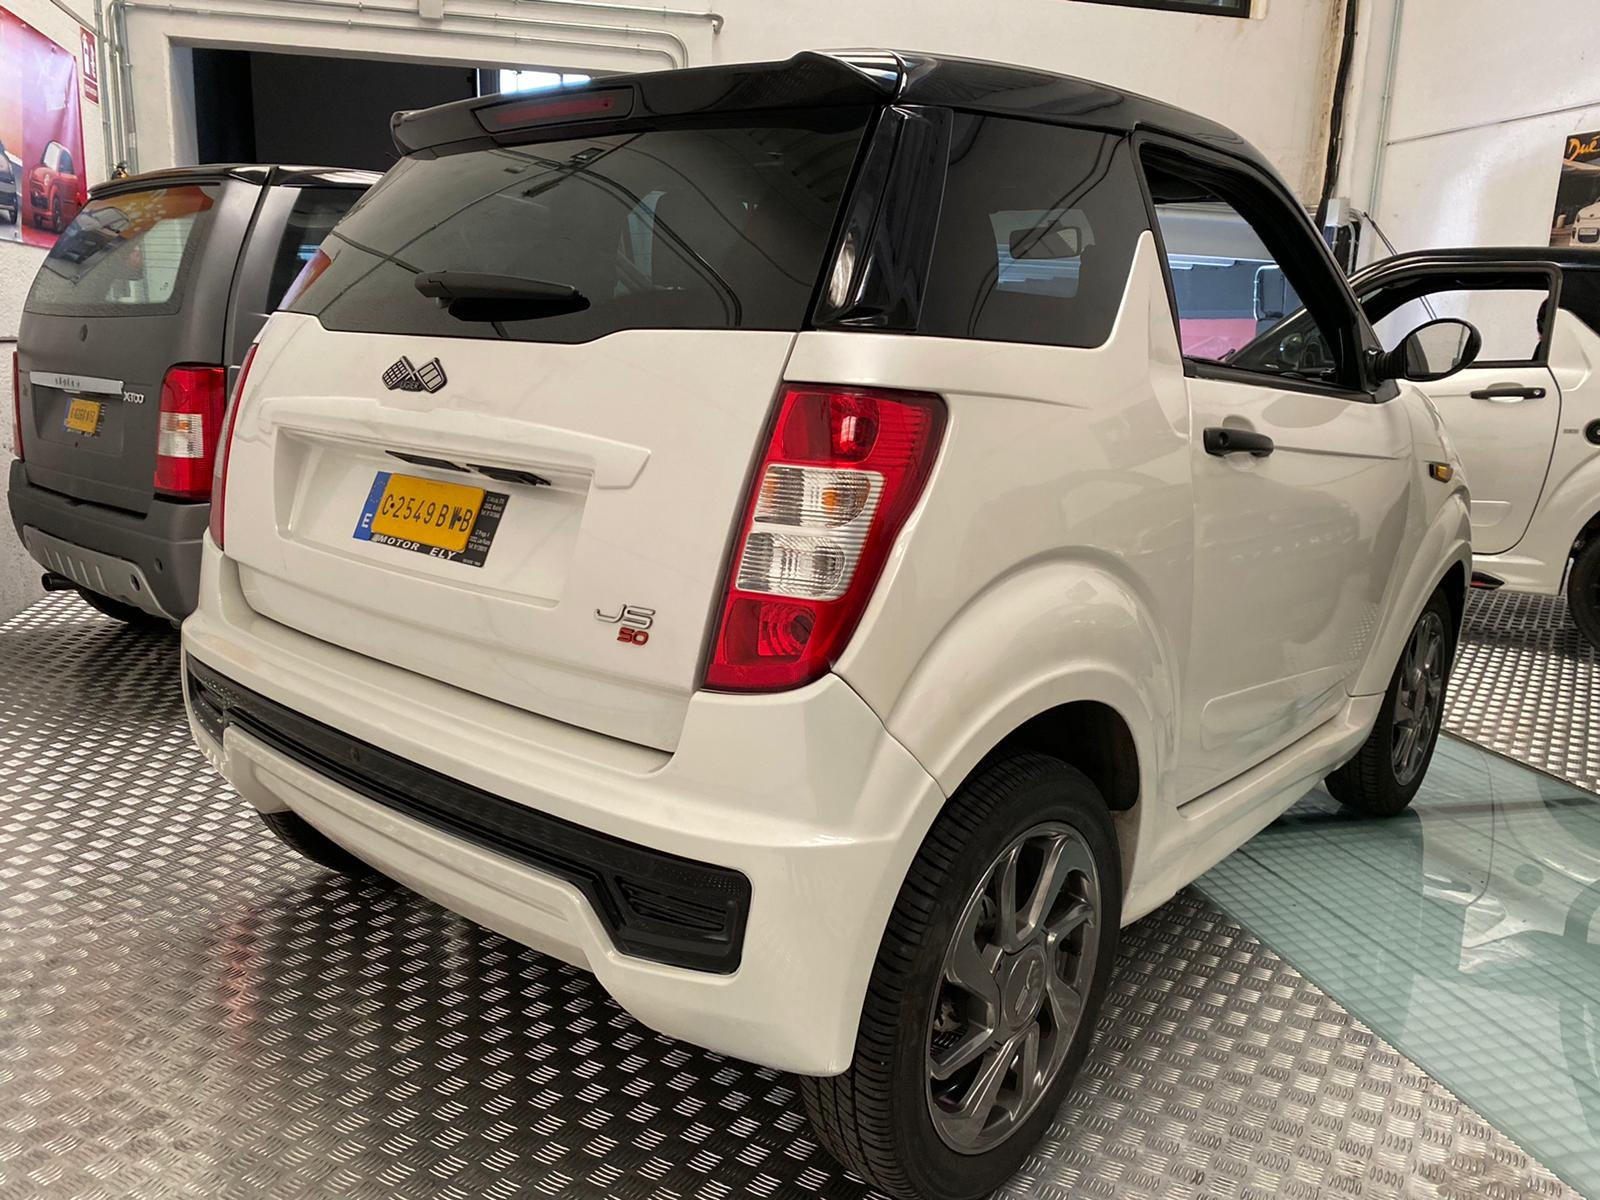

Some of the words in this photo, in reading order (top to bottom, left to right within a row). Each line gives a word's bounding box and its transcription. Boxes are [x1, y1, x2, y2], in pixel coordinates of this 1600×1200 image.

[361, 512, 373, 529] E
[377, 535, 420, 551] MOTOR
[429, 546, 457, 560] ELY
[593, 603, 656, 630] JS
[616, 626, 650, 646] 50
